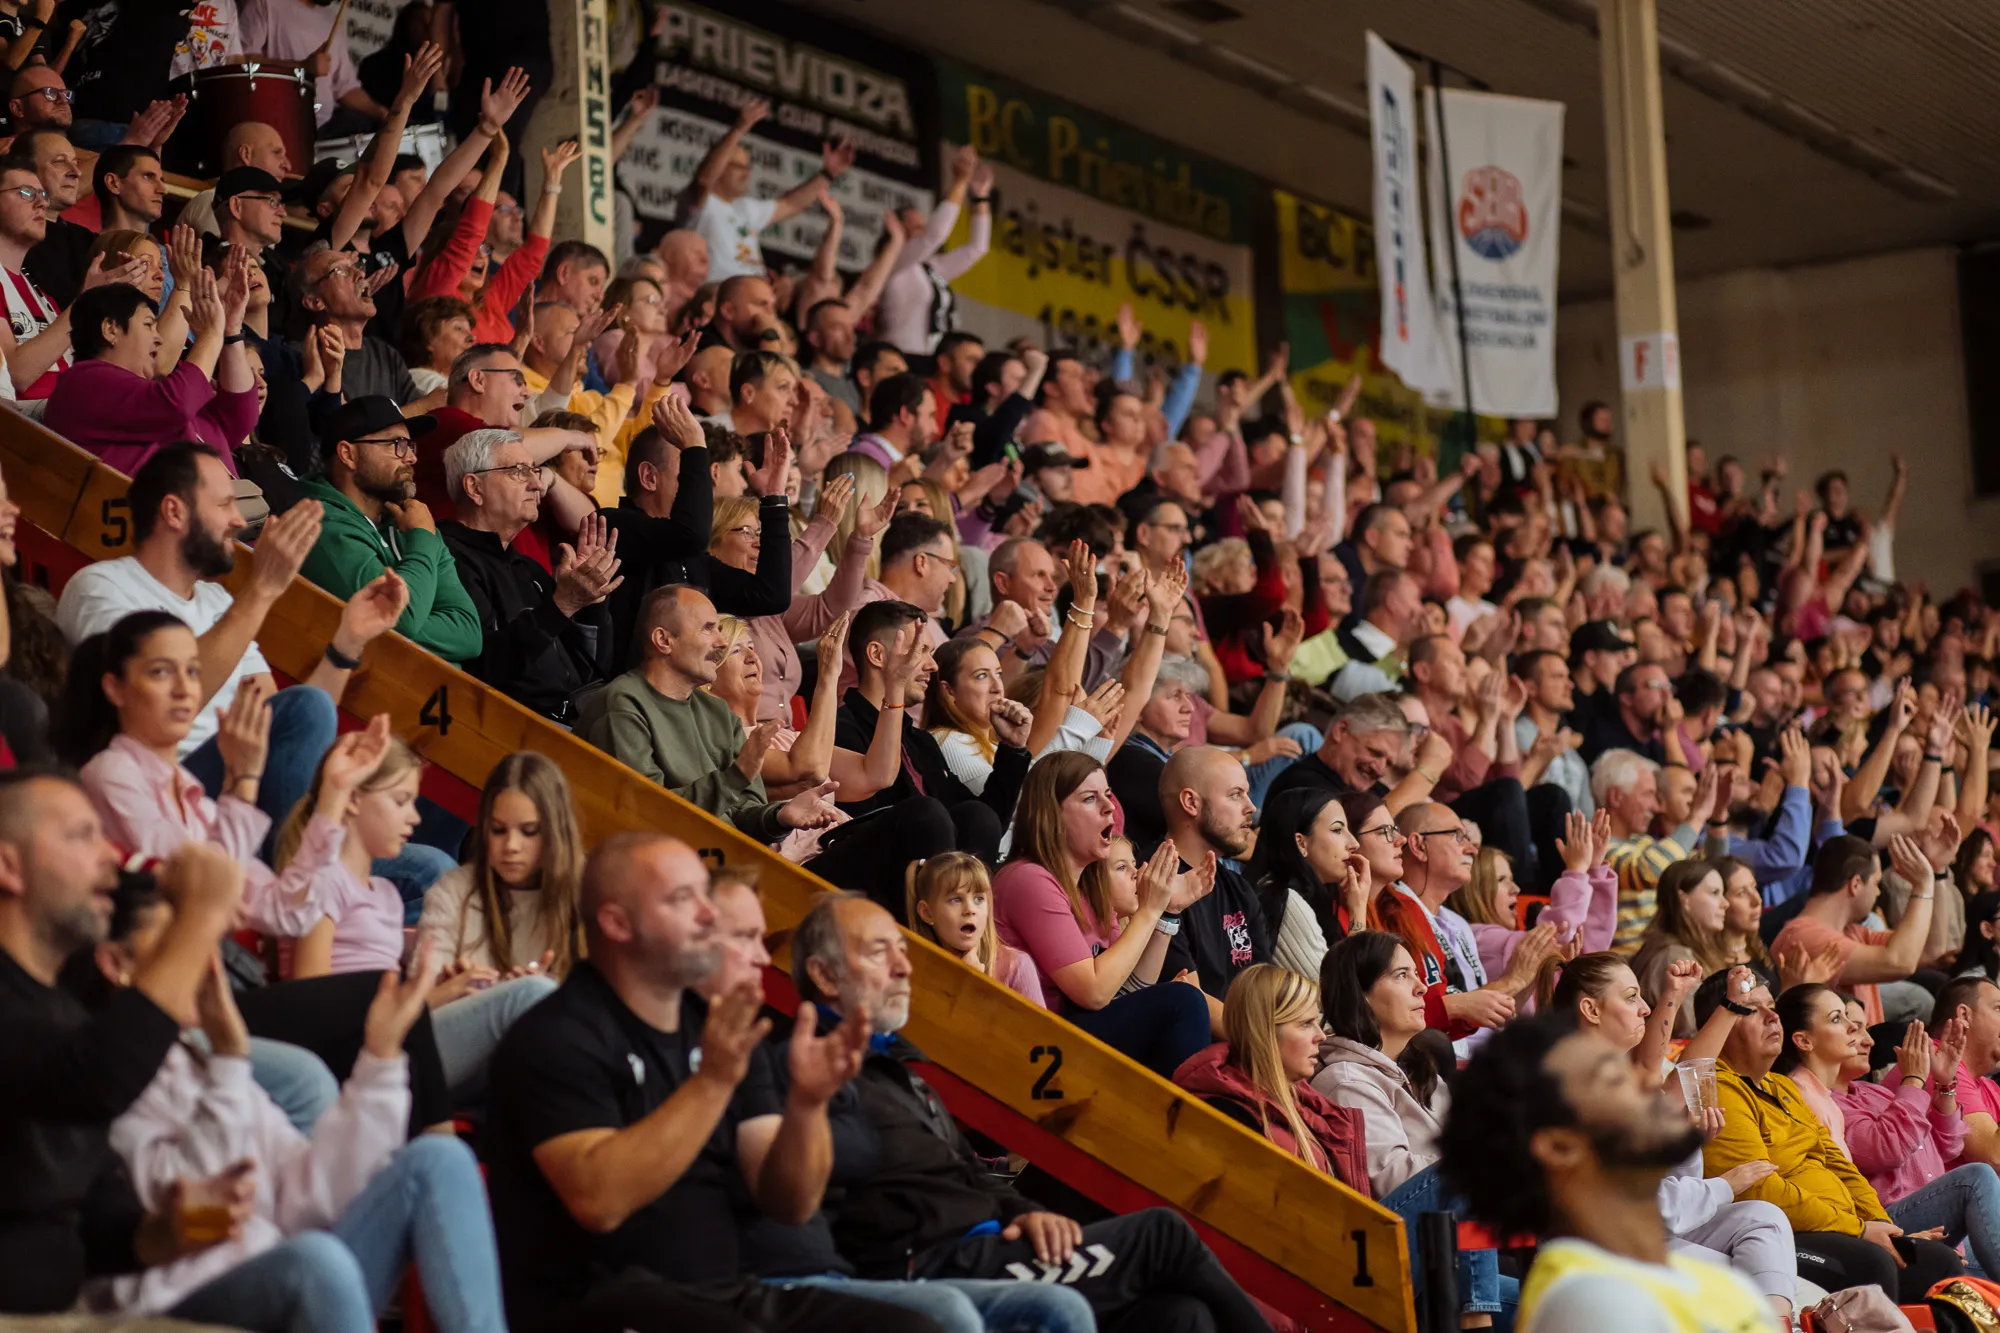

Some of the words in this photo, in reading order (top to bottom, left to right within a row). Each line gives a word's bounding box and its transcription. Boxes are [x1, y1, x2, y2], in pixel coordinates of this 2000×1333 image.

[656, 6, 918, 142] PRIEVIDZA
[101, 498, 127, 547] 5
[420, 684, 453, 736] 4
[1030, 1045, 1064, 1100] 2
[1350, 1229, 1374, 1288] 1
